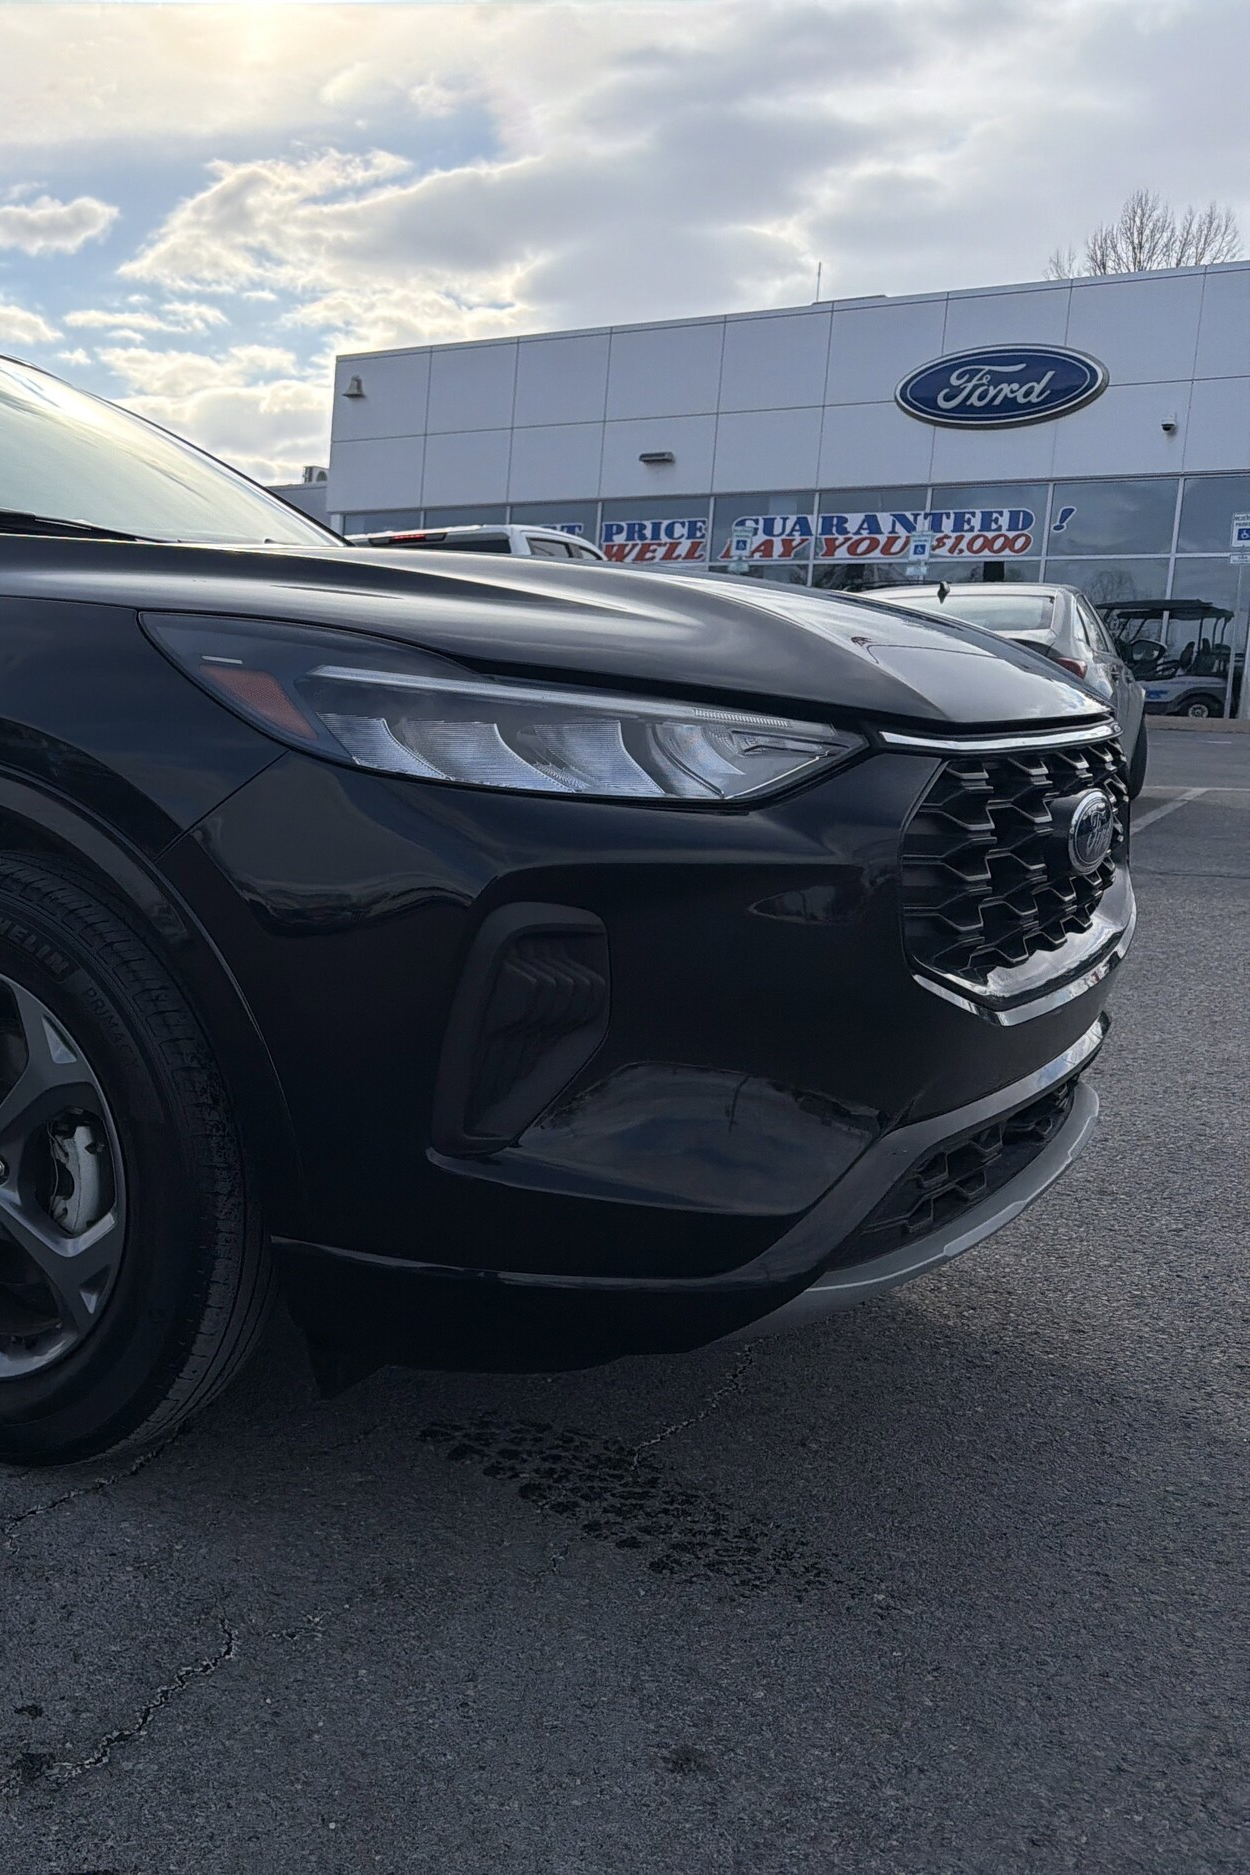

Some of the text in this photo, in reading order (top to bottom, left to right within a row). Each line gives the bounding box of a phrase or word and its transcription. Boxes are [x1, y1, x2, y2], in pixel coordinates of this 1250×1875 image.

[937, 363, 1056, 409] Ford
[603, 519, 707, 542] PRICE
[734, 509, 1034, 537] GUARANTEED
[821, 536, 911, 557] YOU
[932, 533, 1032, 555] $1,000
